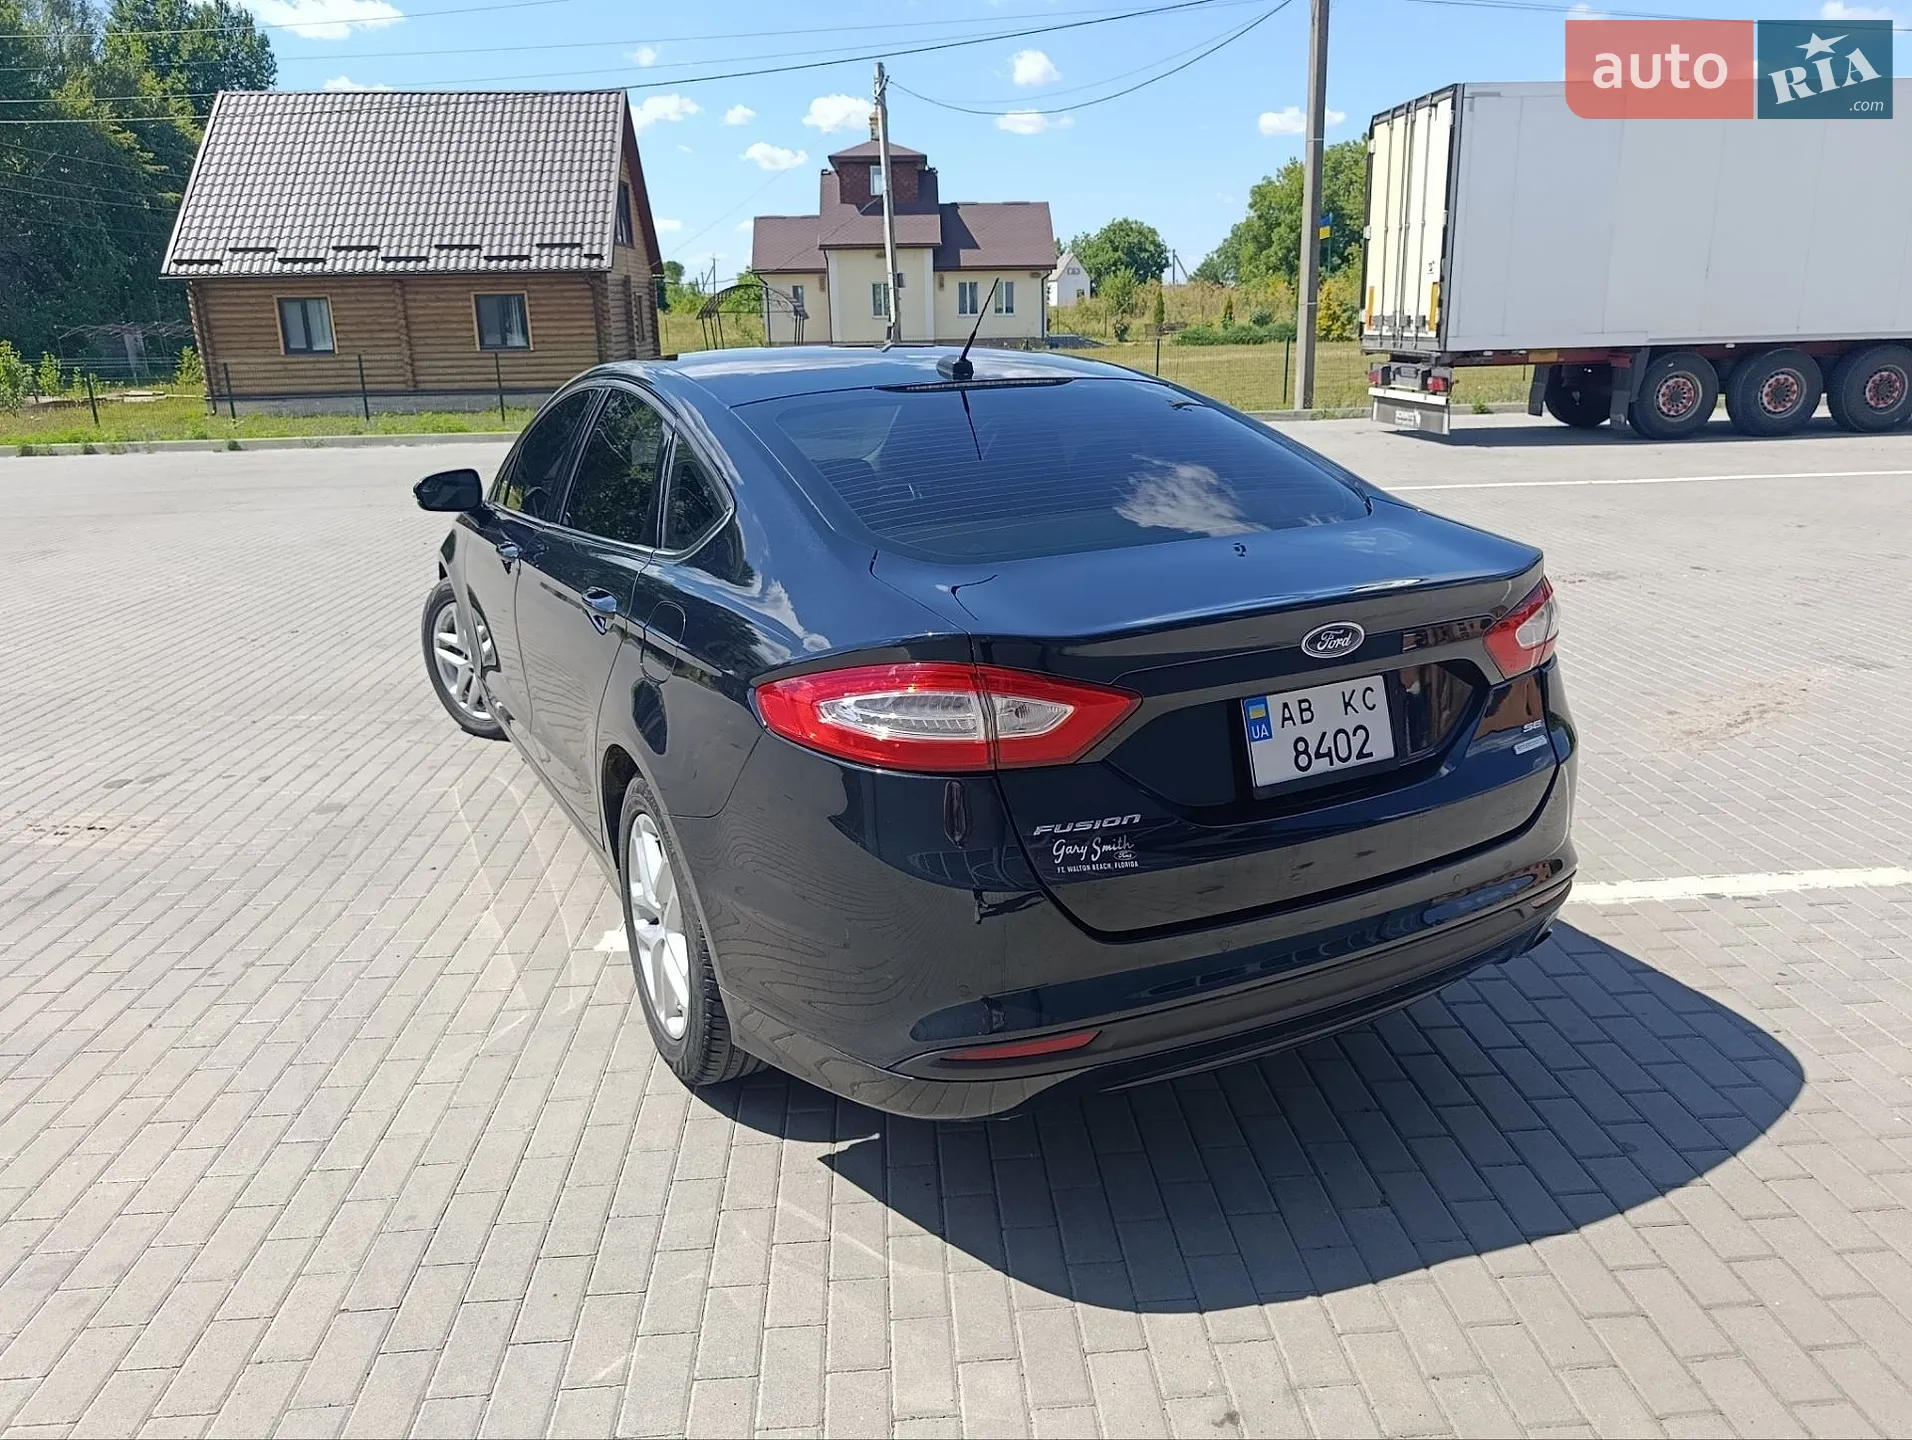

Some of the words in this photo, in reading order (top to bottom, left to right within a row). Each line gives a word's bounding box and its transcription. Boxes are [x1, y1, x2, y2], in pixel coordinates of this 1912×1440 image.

[1317, 629, 1352, 651] Ford
[1281, 698, 1315, 729] AB
[1341, 686, 1377, 716] KC
[1251, 727, 1269, 739] UA
[1293, 724, 1374, 773] 8402
[1033, 813, 1141, 836] FUSION
[1052, 839, 1088, 864] Gary
[1091, 835, 1135, 862] Smith
[1067, 864, 1091, 873] WALTON
[1114, 861, 1139, 869] FLORIDA
